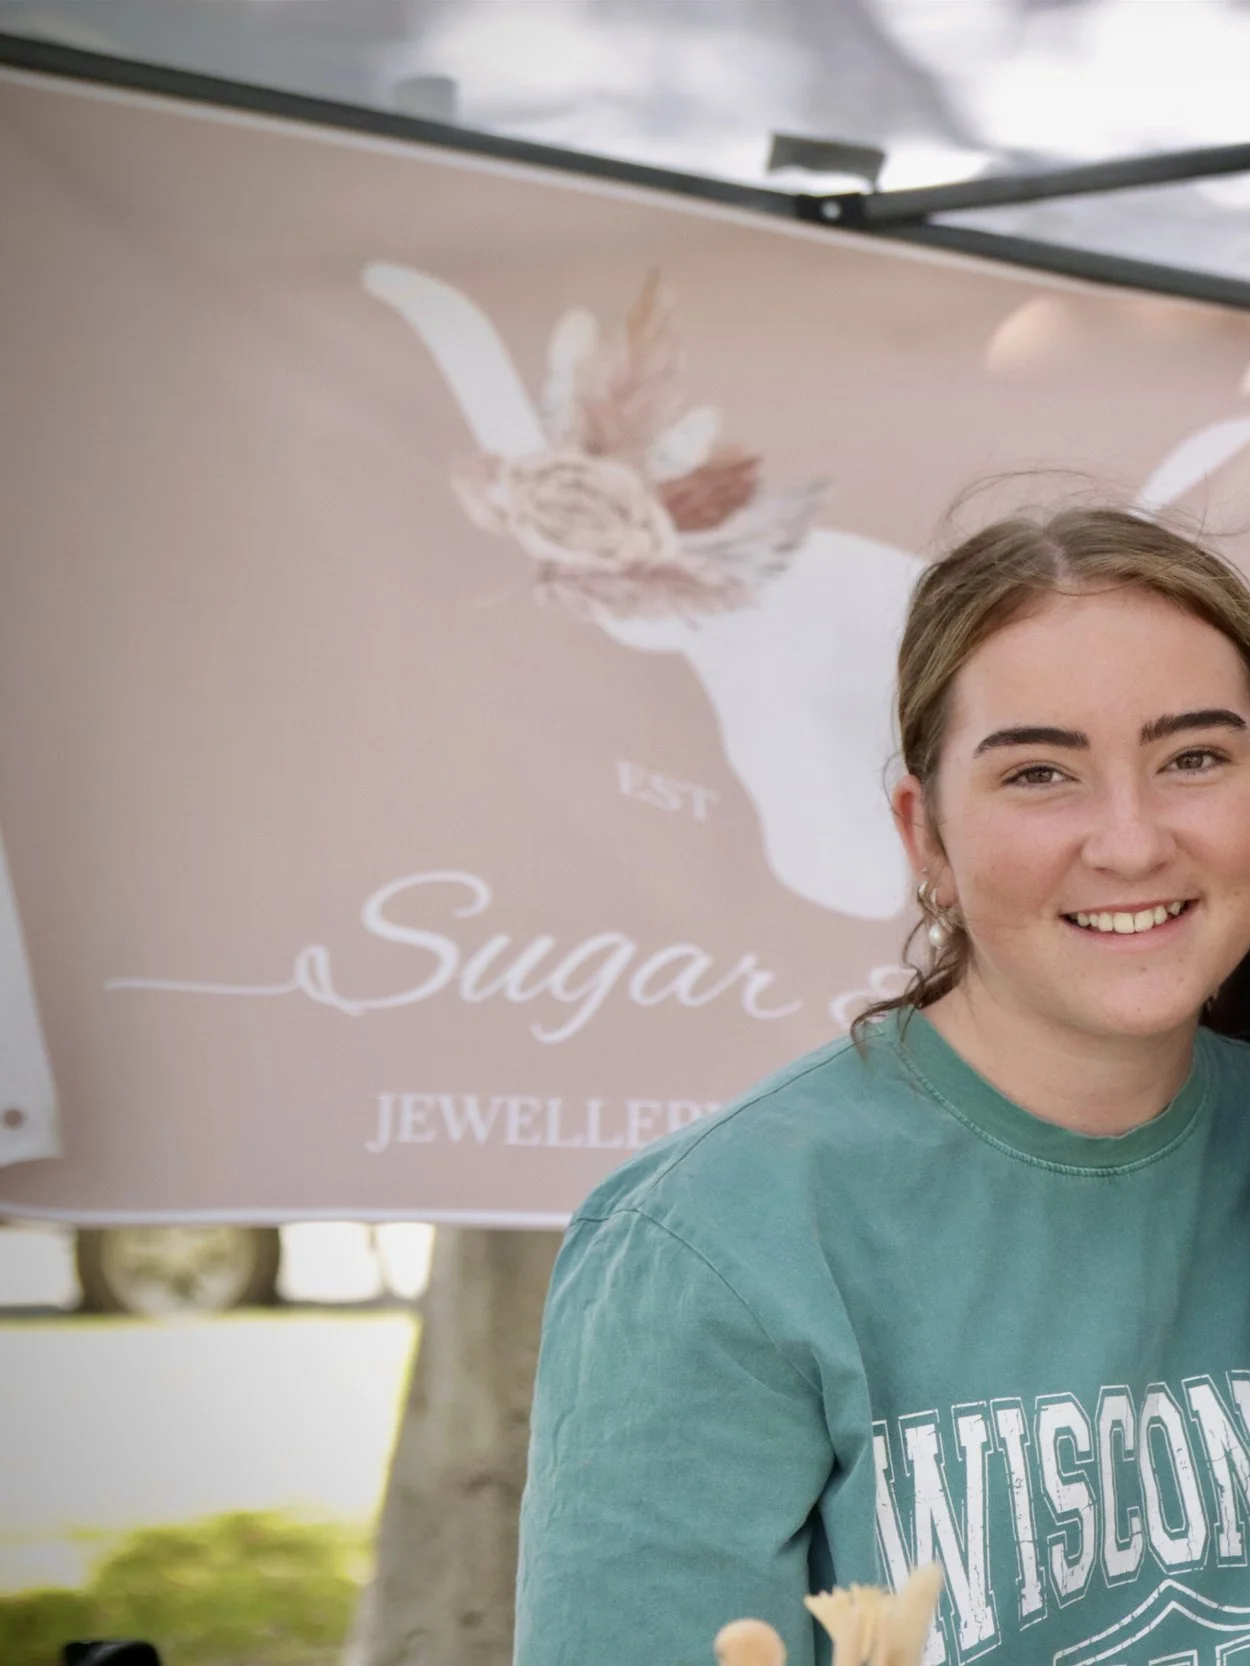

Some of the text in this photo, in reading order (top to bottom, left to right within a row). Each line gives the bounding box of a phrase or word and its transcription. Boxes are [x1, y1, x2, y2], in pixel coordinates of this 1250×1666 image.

[615, 760, 721, 823] EST
[293, 872, 806, 1044] Sugar
[365, 1091, 724, 1154] JEWELLER
